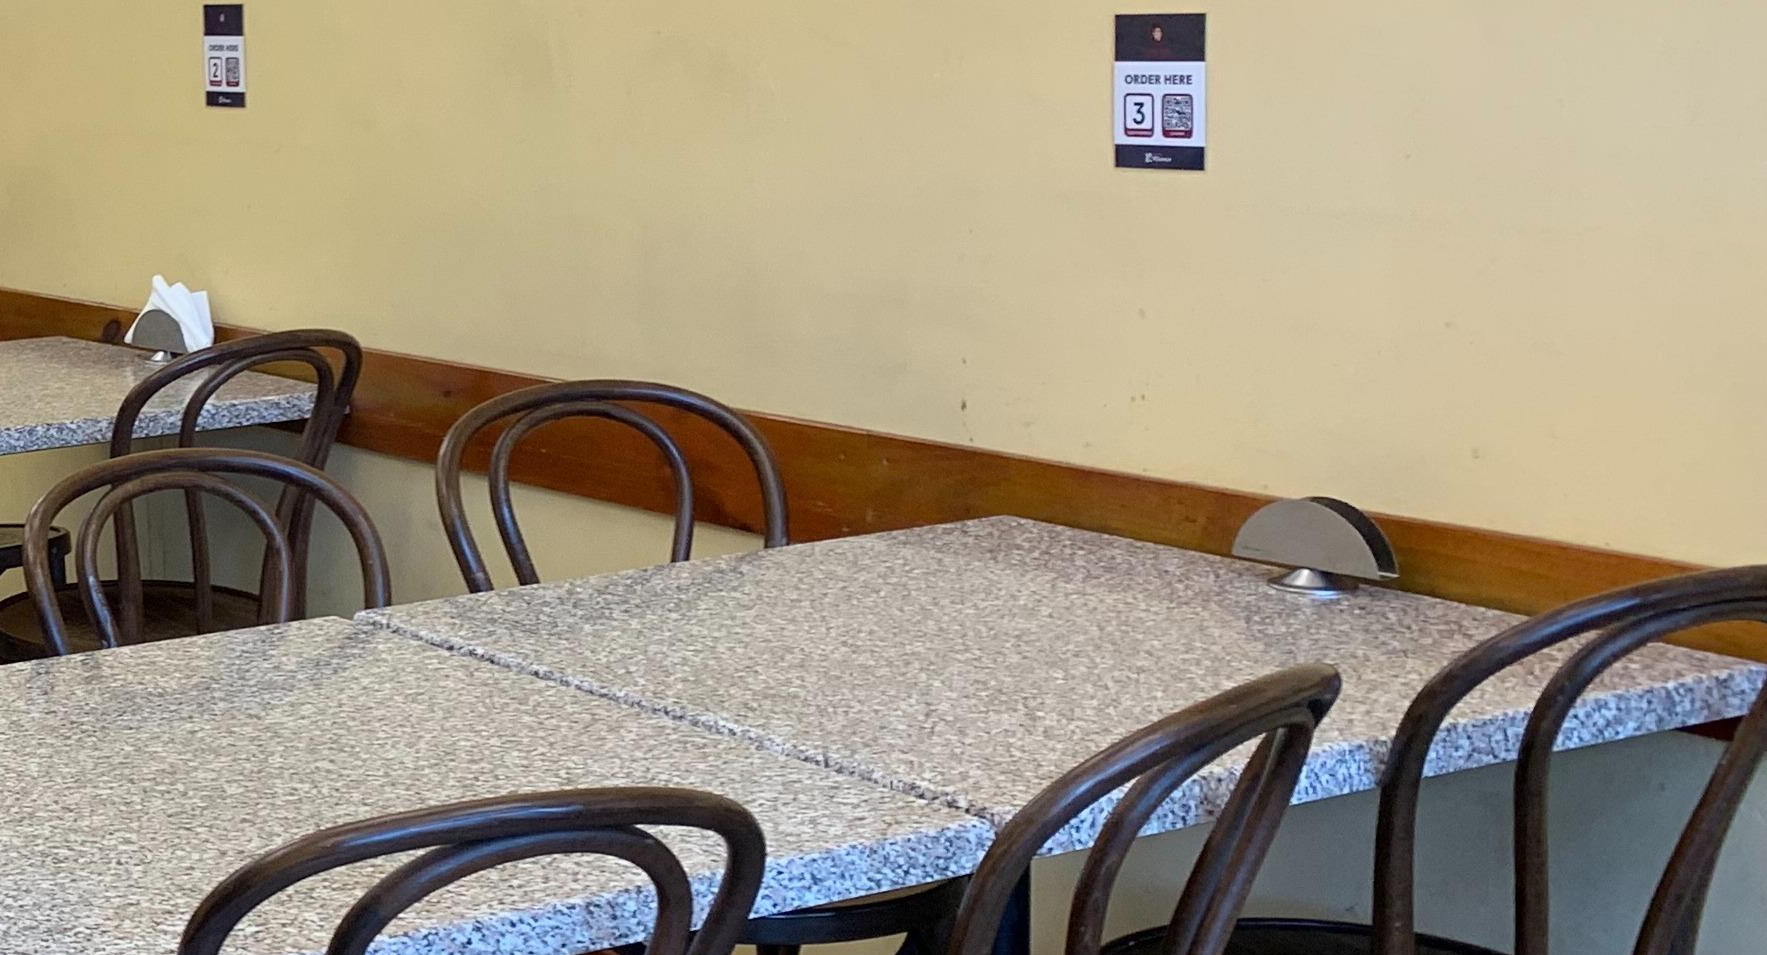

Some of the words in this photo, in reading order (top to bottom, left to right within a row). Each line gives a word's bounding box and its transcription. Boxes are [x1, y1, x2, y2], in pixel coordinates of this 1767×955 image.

[213, 62, 219, 78] 2
[1124, 74, 1162, 85] ORDER
[1164, 74, 1193, 85] HERE
[1132, 101, 1146, 125] 3
